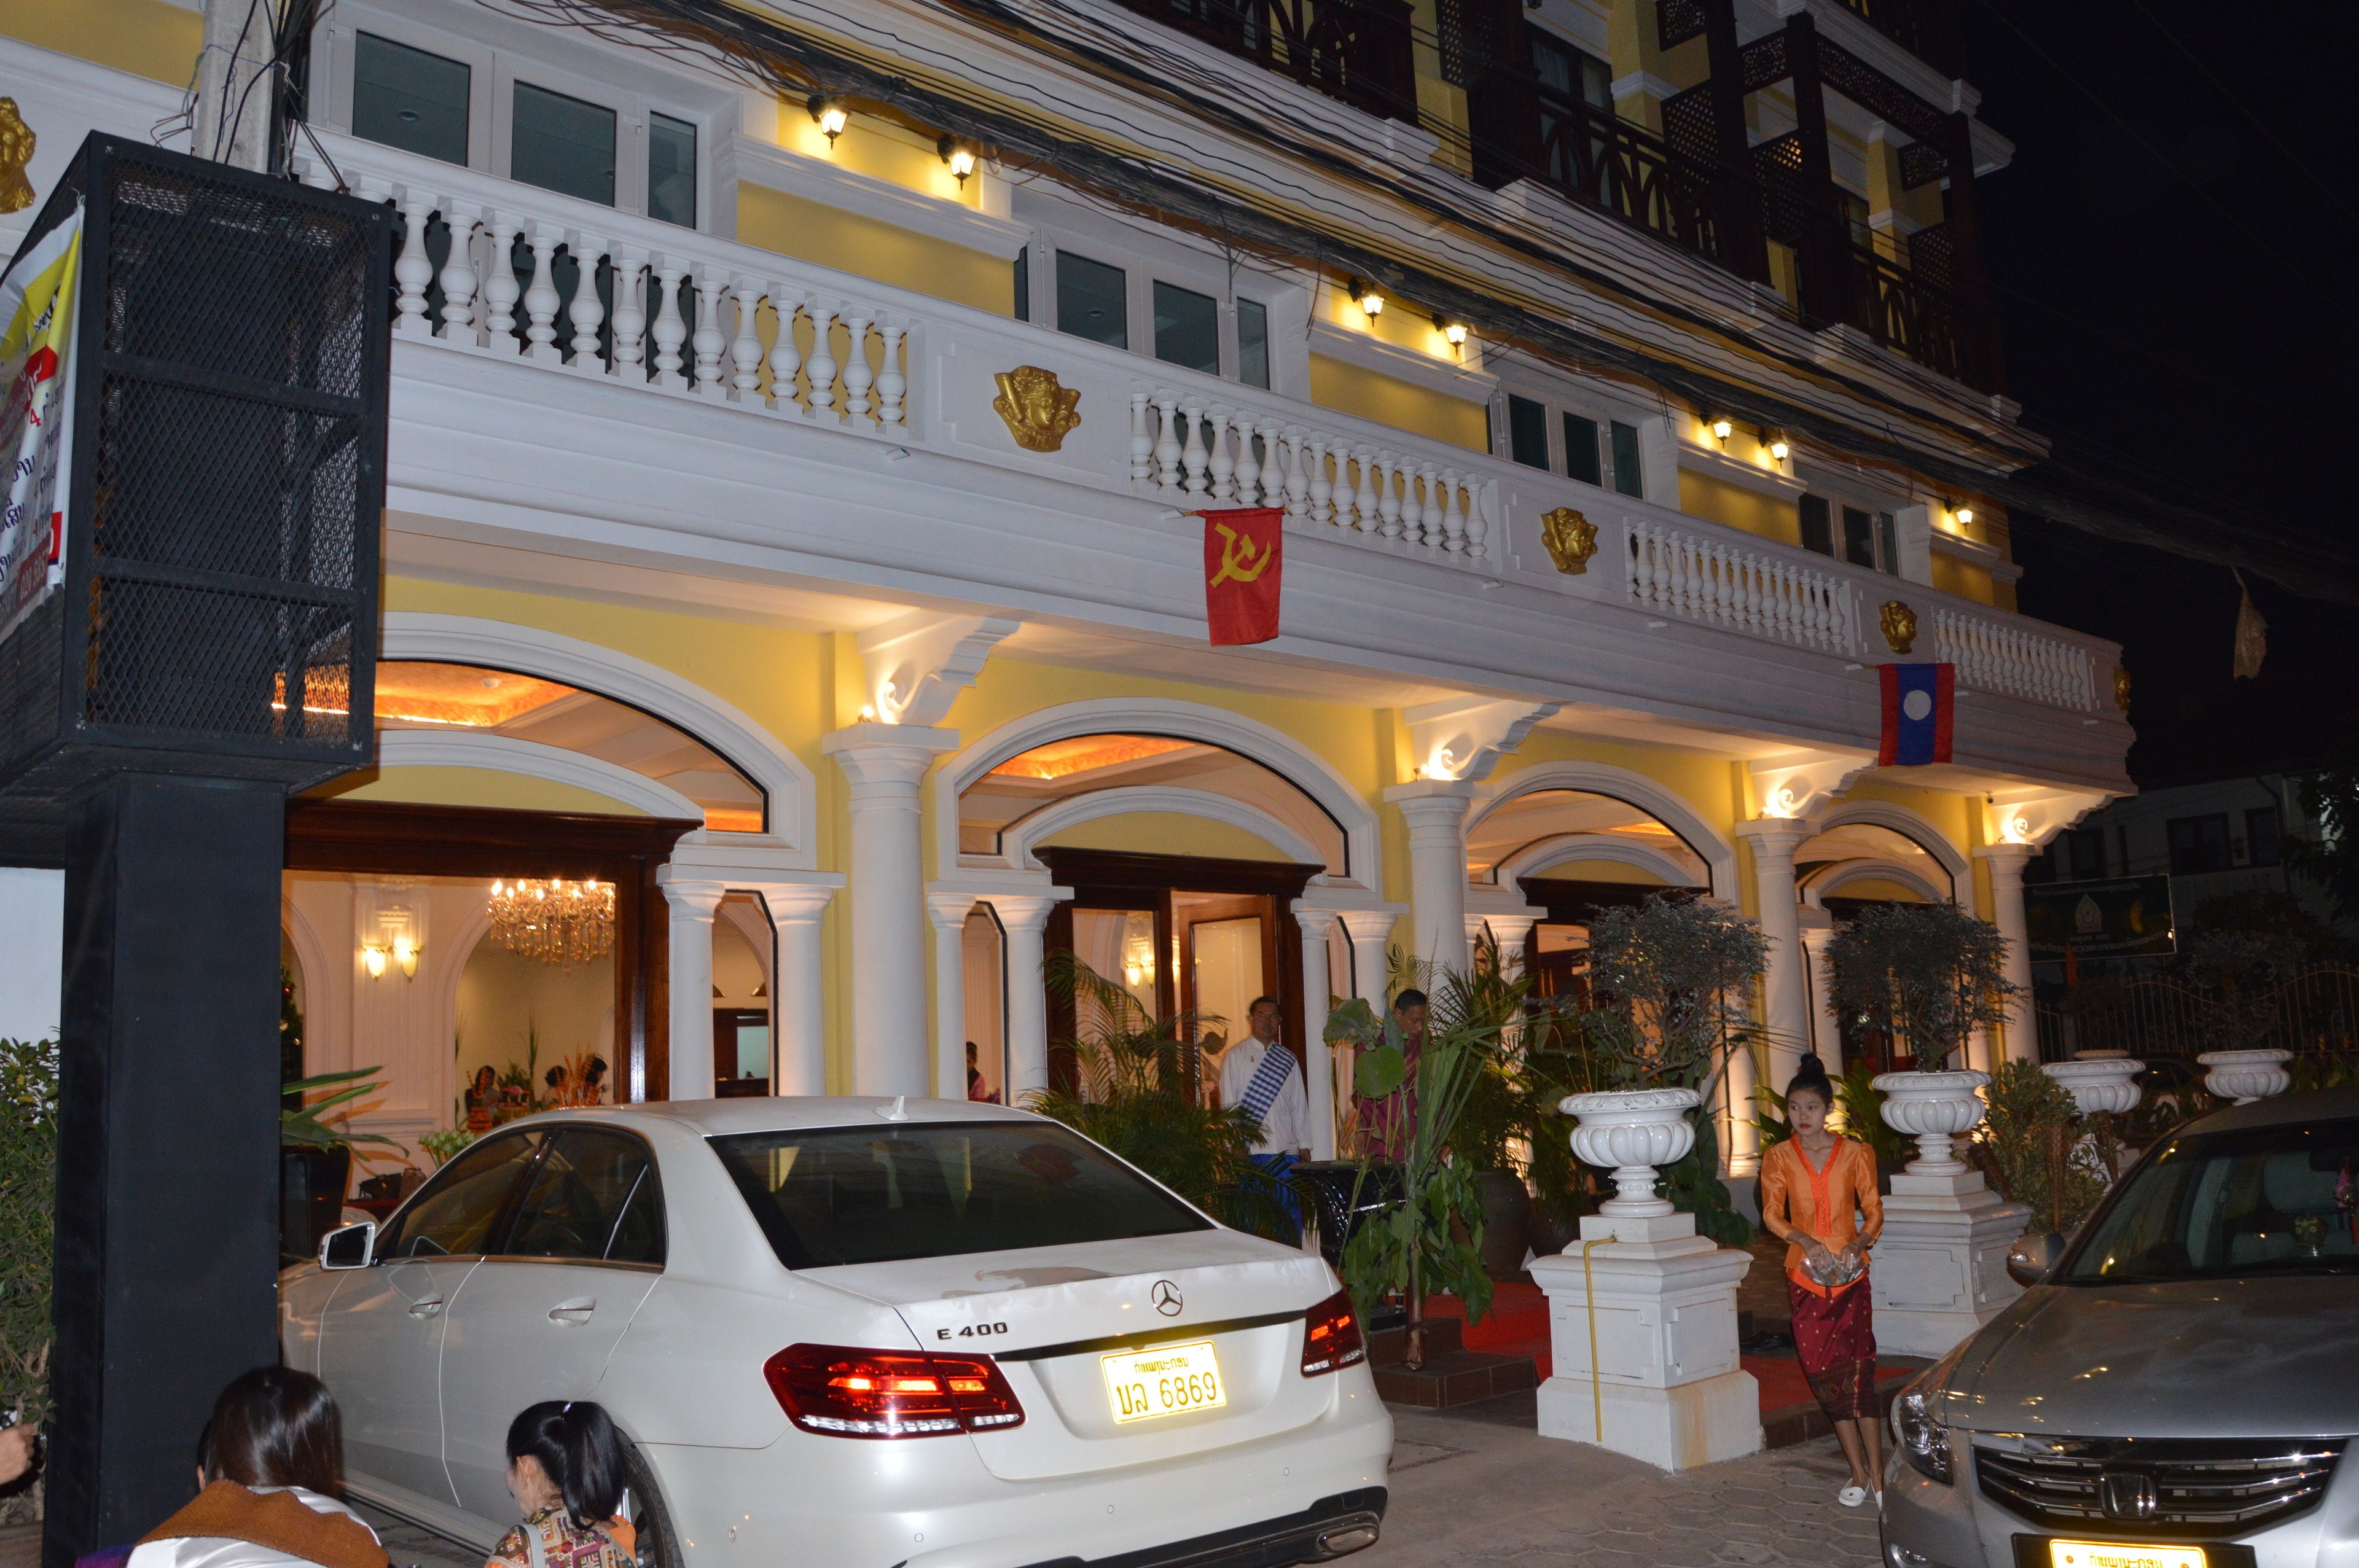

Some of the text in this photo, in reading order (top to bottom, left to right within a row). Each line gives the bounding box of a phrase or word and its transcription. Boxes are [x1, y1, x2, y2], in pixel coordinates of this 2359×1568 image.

[937, 1322, 1007, 1340] E 400
[1159, 1371, 1216, 1408] 6869
